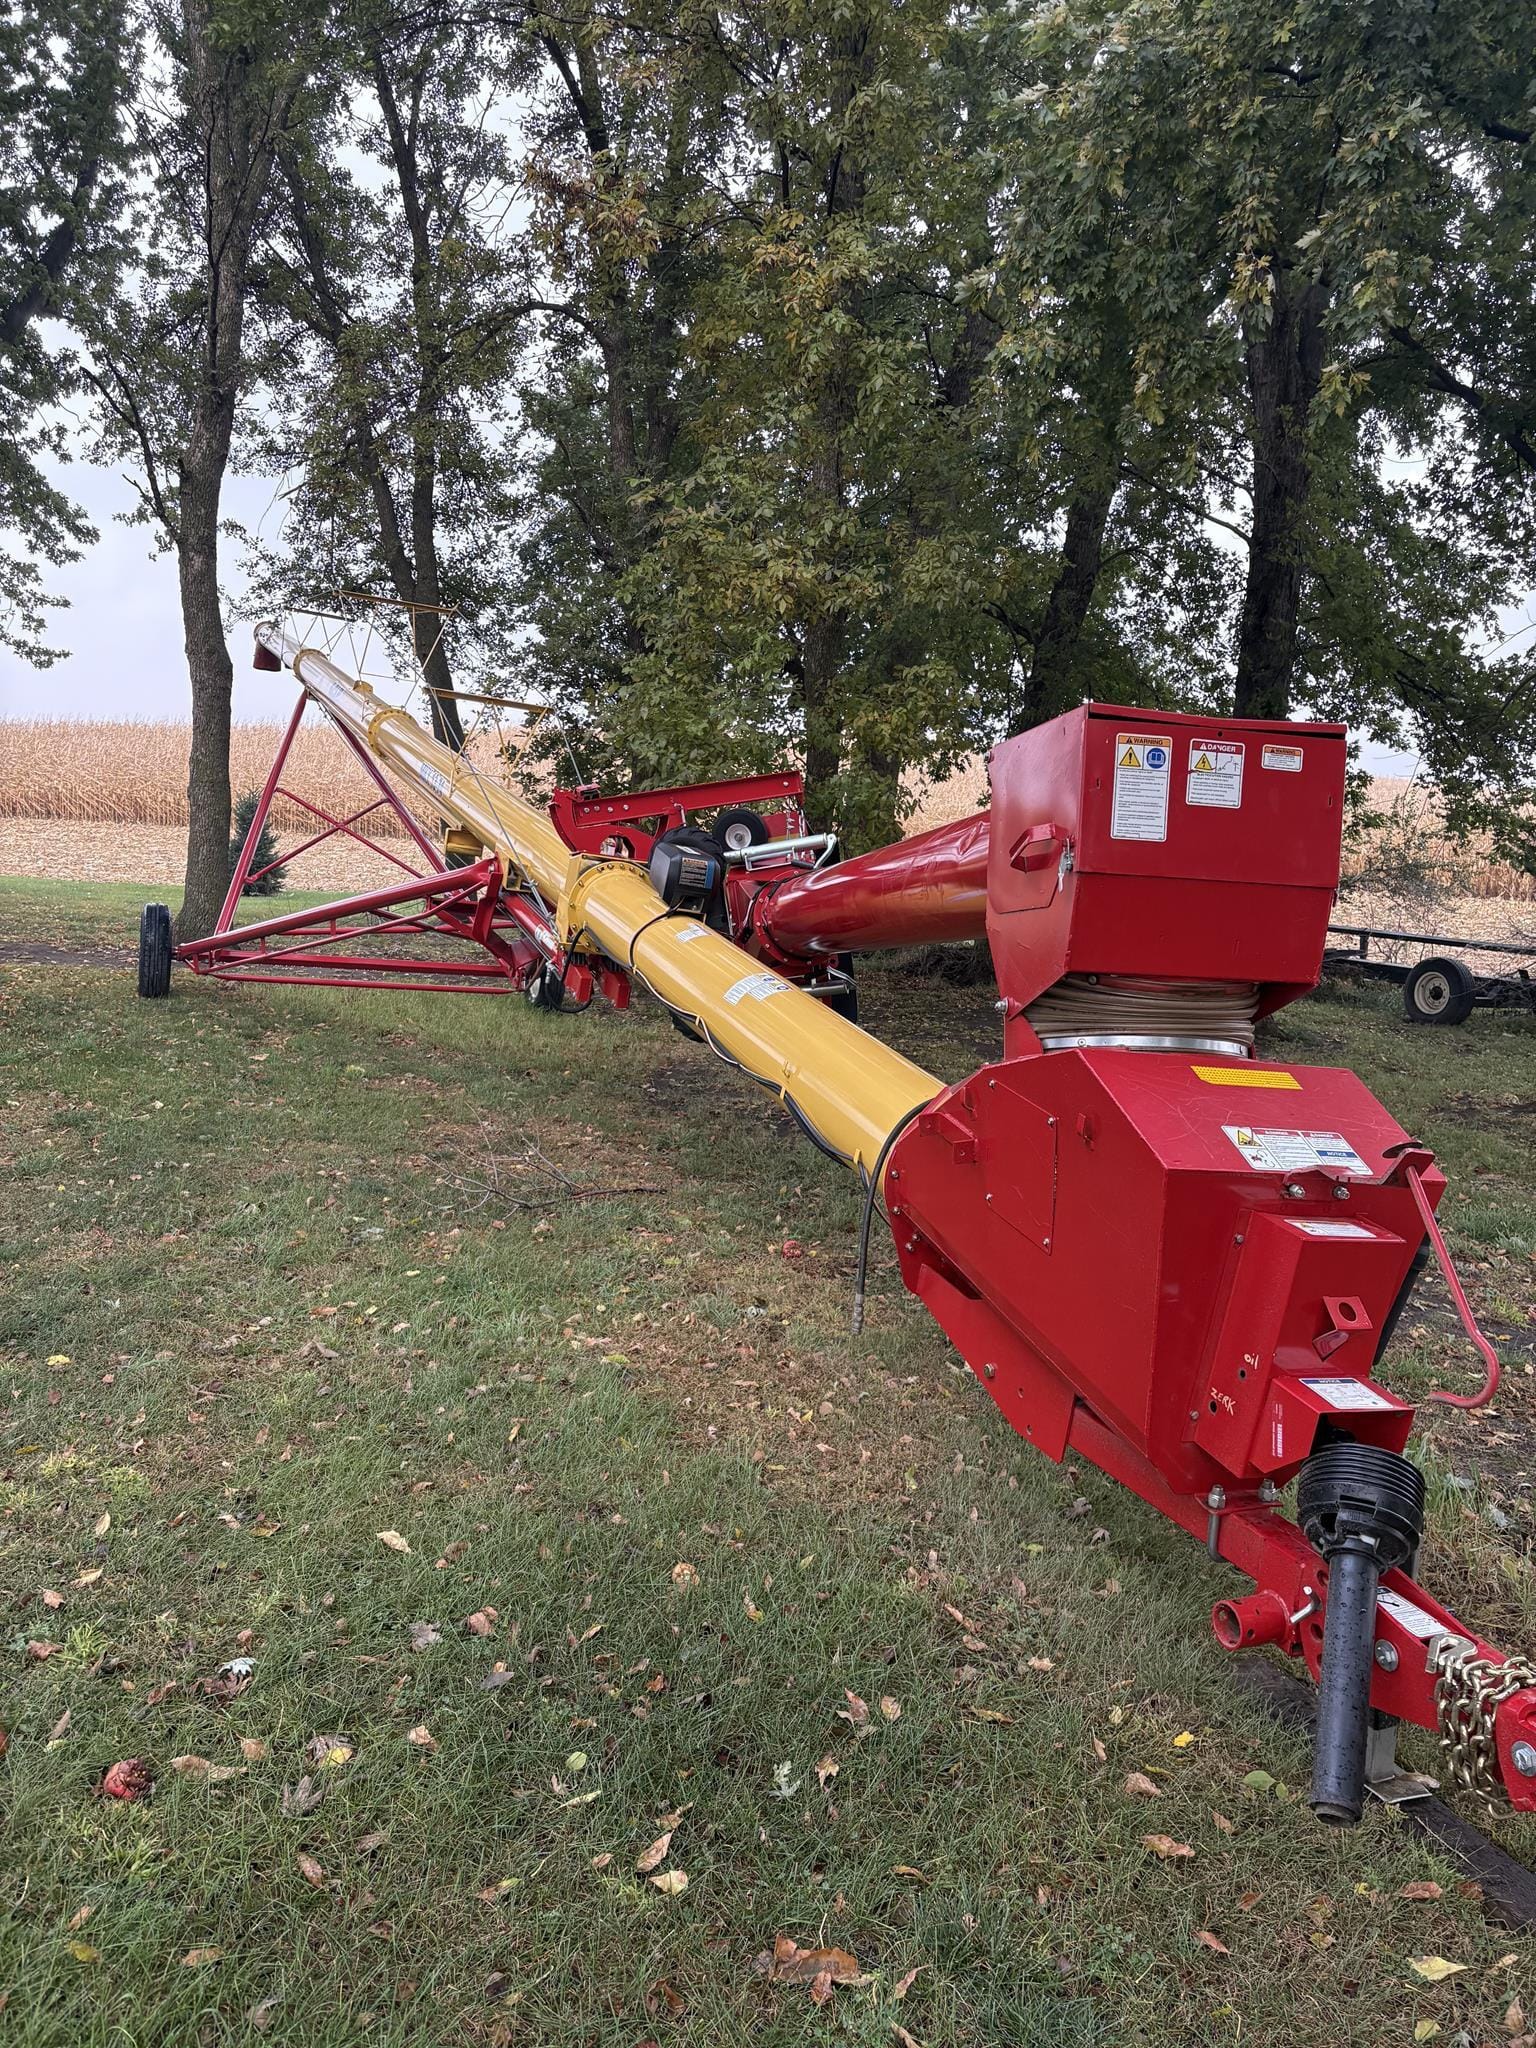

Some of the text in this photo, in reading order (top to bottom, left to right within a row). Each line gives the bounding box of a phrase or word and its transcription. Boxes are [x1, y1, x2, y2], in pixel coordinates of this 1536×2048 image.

[1133, 737, 1163, 746] WARNING
[1207, 743, 1236, 753] DANGER
[1210, 1387, 1236, 1416] ZERK
